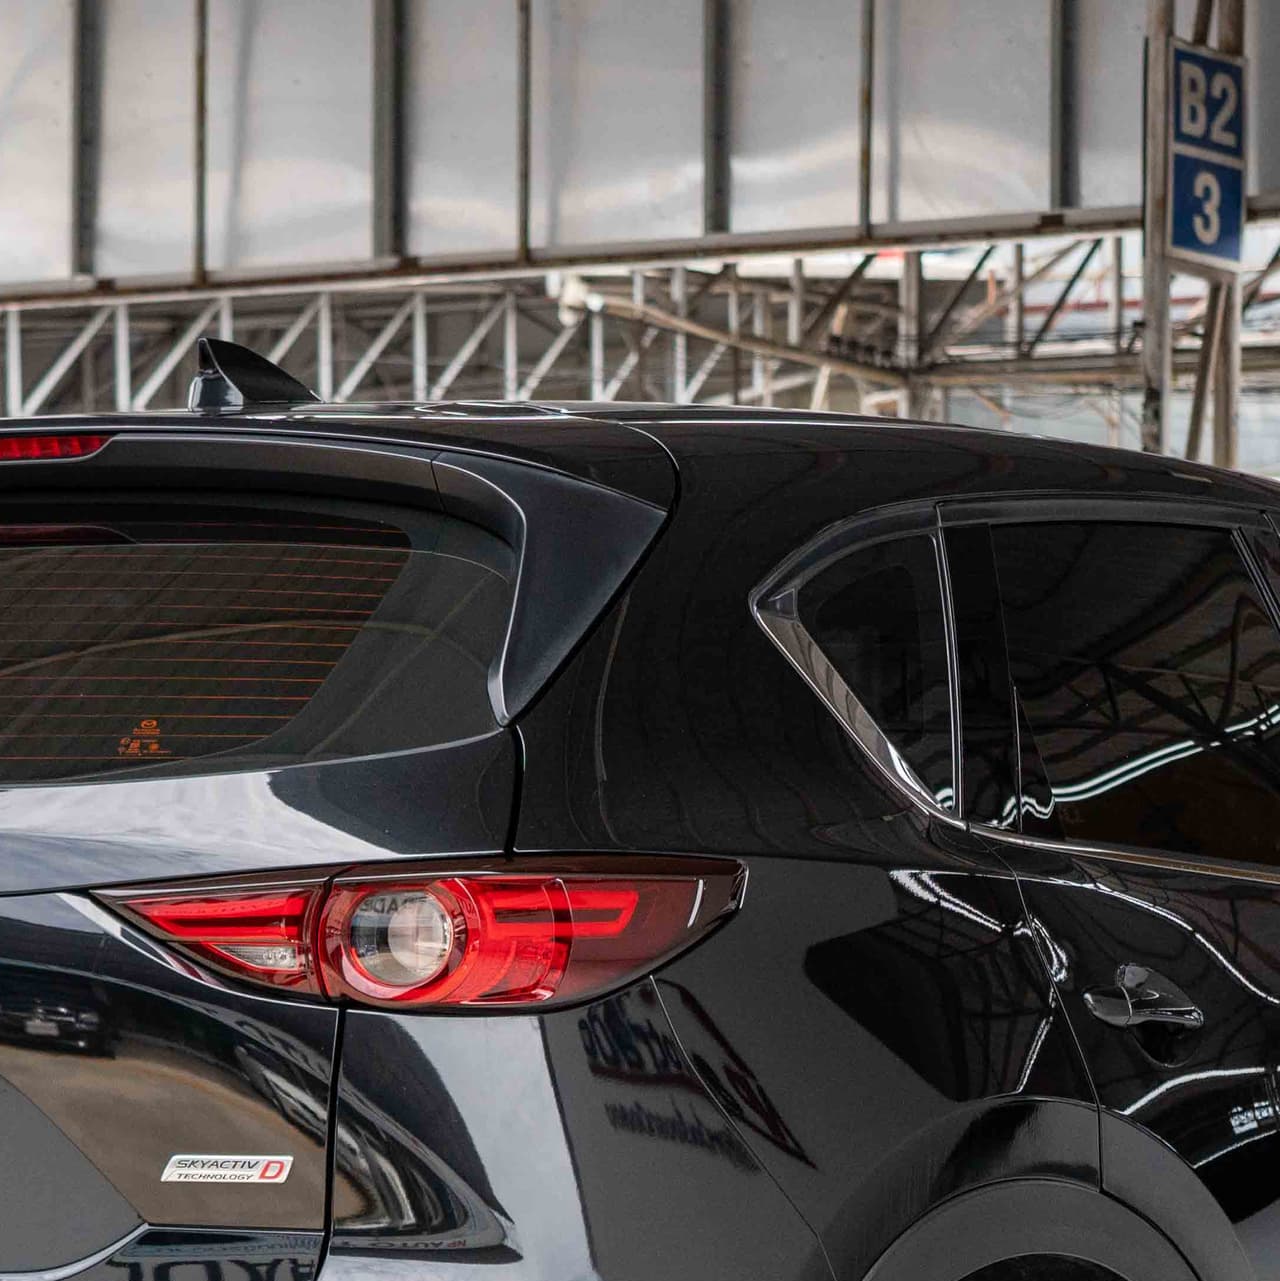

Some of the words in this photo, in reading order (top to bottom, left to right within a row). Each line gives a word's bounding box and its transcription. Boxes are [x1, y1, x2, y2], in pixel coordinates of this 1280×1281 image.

[1179, 60, 1238, 148] B2
[1192, 171, 1222, 245] 3
[176, 1160, 260, 1170] SKYACTIV
[176, 1172, 255, 1181] TECHNOLOGY
